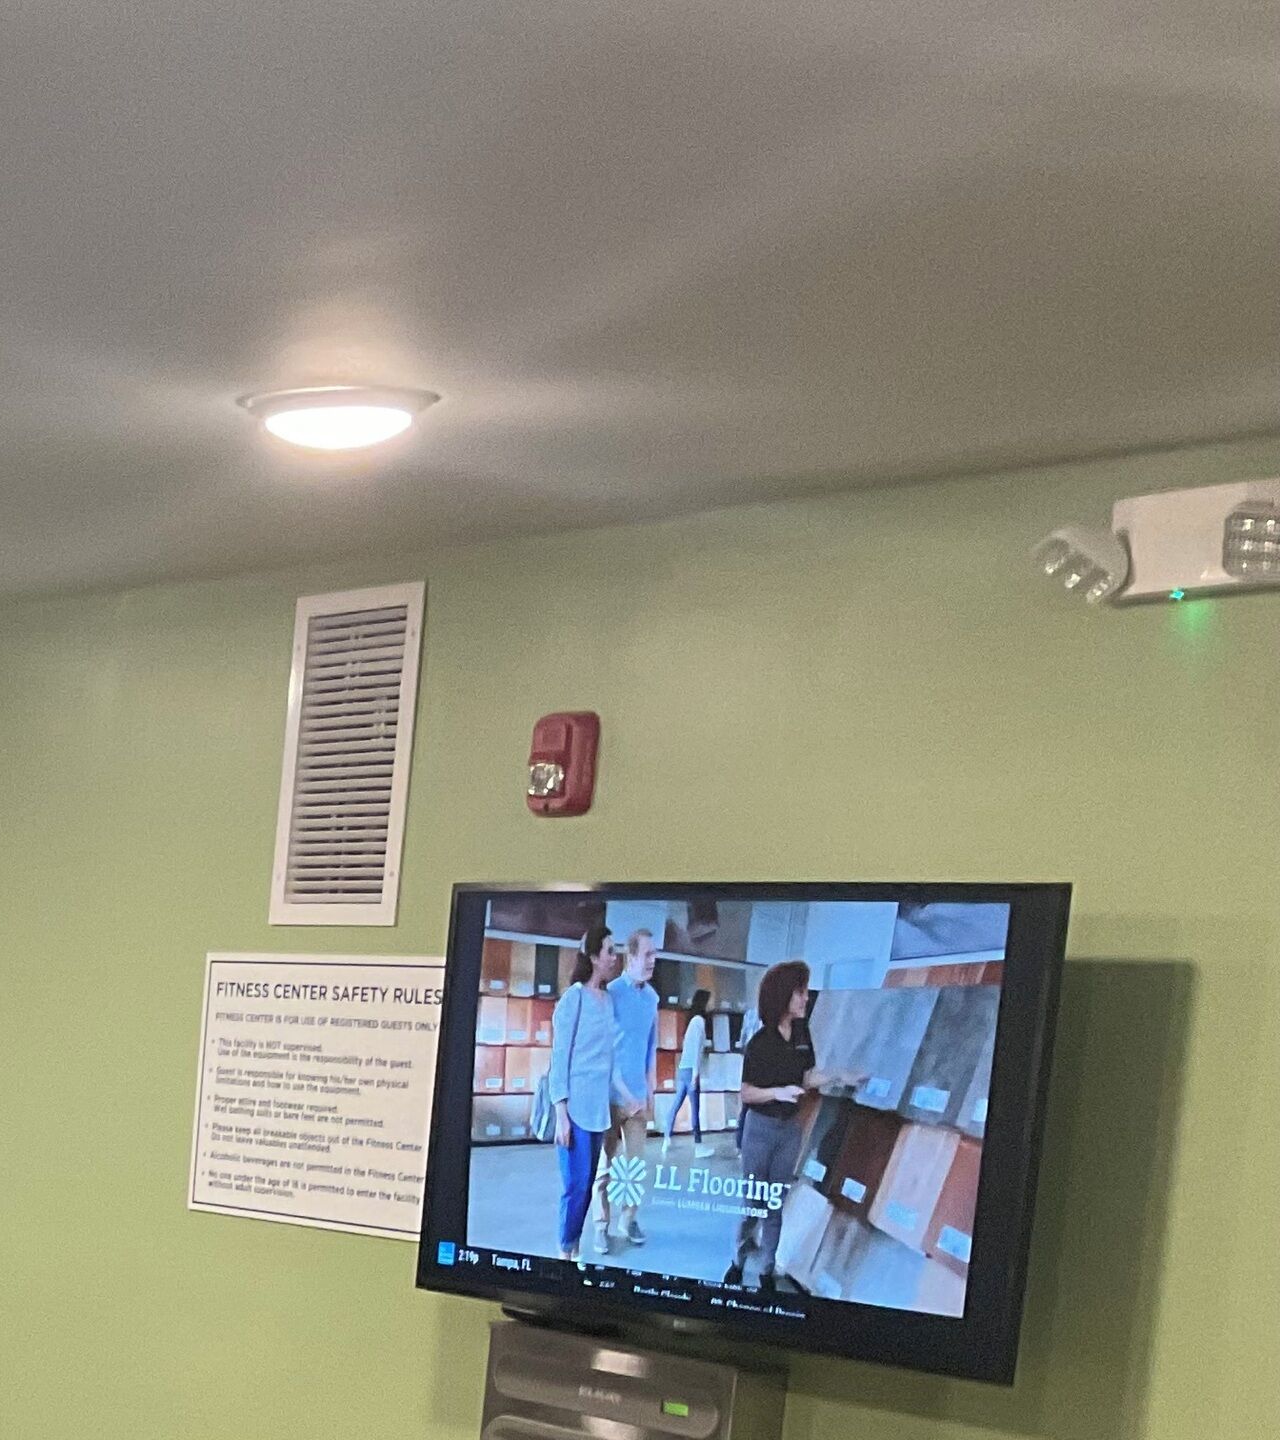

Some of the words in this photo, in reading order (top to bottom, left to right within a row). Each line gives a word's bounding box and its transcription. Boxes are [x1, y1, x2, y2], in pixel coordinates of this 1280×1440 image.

[217, 982, 269, 998] FITNESS
[274, 983, 328, 1000] CENTER
[332, 985, 388, 1003] SAFETY
[393, 988, 443, 1005] RULES
[216, 1012, 243, 1021] FITNESS
[246, 1013, 273, 1023] CENTER
[275, 1014, 282, 1023] IS
[284, 1015, 298, 1024] FOR
[301, 1016, 315, 1025] USE
[318, 1017, 328, 1026] OF
[330, 1018, 379, 1028] REGISTERED
[380, 1020, 412, 1030] GUESTS
[415, 1022, 438, 1032] ONLY
[219, 1038, 232, 1047] This
[234, 1039, 256, 1050] facility
[266, 1041, 281, 1049] NOT
[300, 1053, 310, 1061] the
[313, 1055, 363, 1066] responsibility
[366, 1057, 373, 1066] of
[375, 1058, 386, 1066] the
[376, 1079, 408, 1089] physical
[284, 1111, 299, 1119] bare
[328, 1136, 340, 1144] out
[342, 1136, 350, 1144] of
[352, 1138, 364, 1146] the
[366, 1138, 393, 1150] Fitness
[242, 1156, 278, 1168] beverages
[306, 1164, 342, 1174] permitted
[353, 1168, 366, 1176] the
[368, 1169, 396, 1181] Fitness
[254, 1175, 266, 1183] the
[268, 1179, 280, 1187] age
[308, 1184, 344, 1194] permitted
[346, 1187, 354, 1196] to
[356, 1190, 376, 1198] enter
[378, 1191, 391, 1200] the
[654, 1165, 681, 1191] LL
[688, 1168, 783, 1209] Flooring
[521, 1259, 532, 1271] FL
